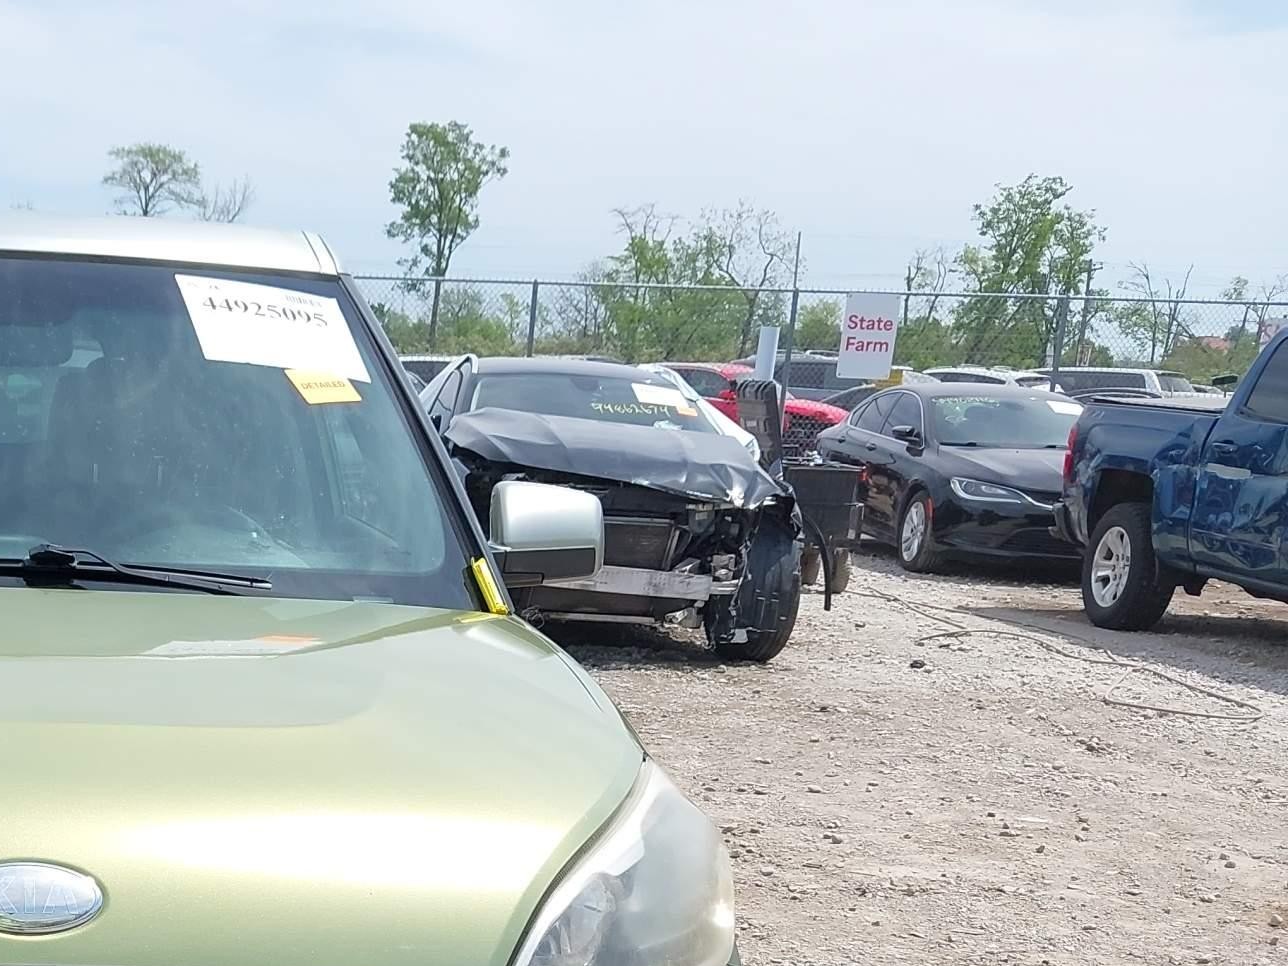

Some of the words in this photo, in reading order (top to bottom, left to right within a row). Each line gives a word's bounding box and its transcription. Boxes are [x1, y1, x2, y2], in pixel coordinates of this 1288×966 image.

[202, 296, 328, 327] 44925095
[847, 314, 894, 332] State
[845, 336, 890, 353] Farm
